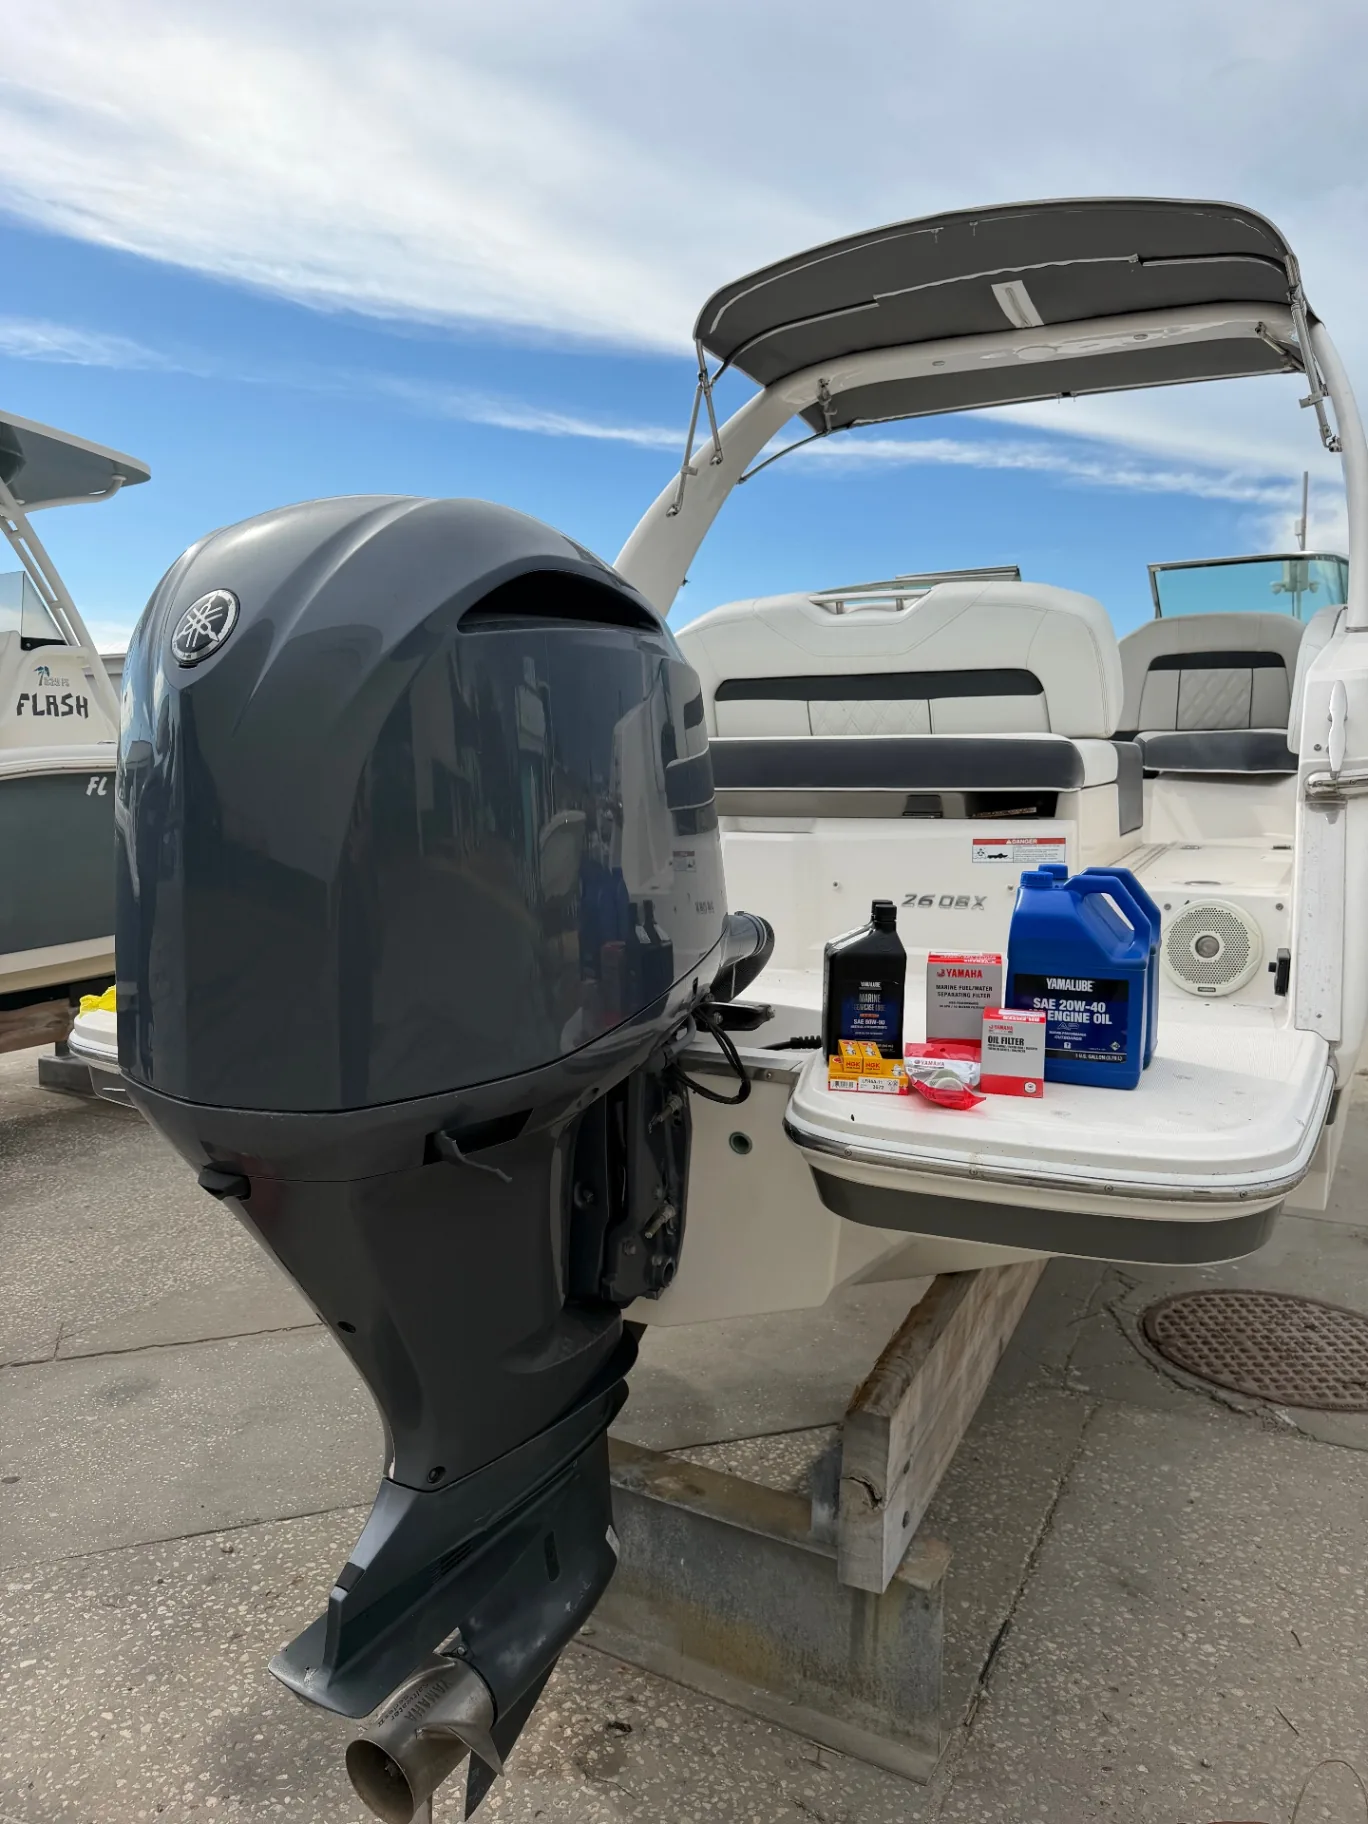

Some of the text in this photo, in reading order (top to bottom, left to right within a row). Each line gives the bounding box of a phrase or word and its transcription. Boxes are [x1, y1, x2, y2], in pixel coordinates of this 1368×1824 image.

[16, 692, 89, 719] FLASH
[86, 776, 108, 796] FL
[946, 968, 983, 979] YAMAHA
[1046, 977, 1095, 992] YAMALUBE
[1033, 997, 1106, 1013] SAE 20W-40
[1047, 1010, 1090, 1024] ENGINE
[1093, 1013, 1113, 1025] OIL
[987, 1035, 1025, 1046] OIL FILTER
[404, 1679, 452, 1721] YAMAHA
